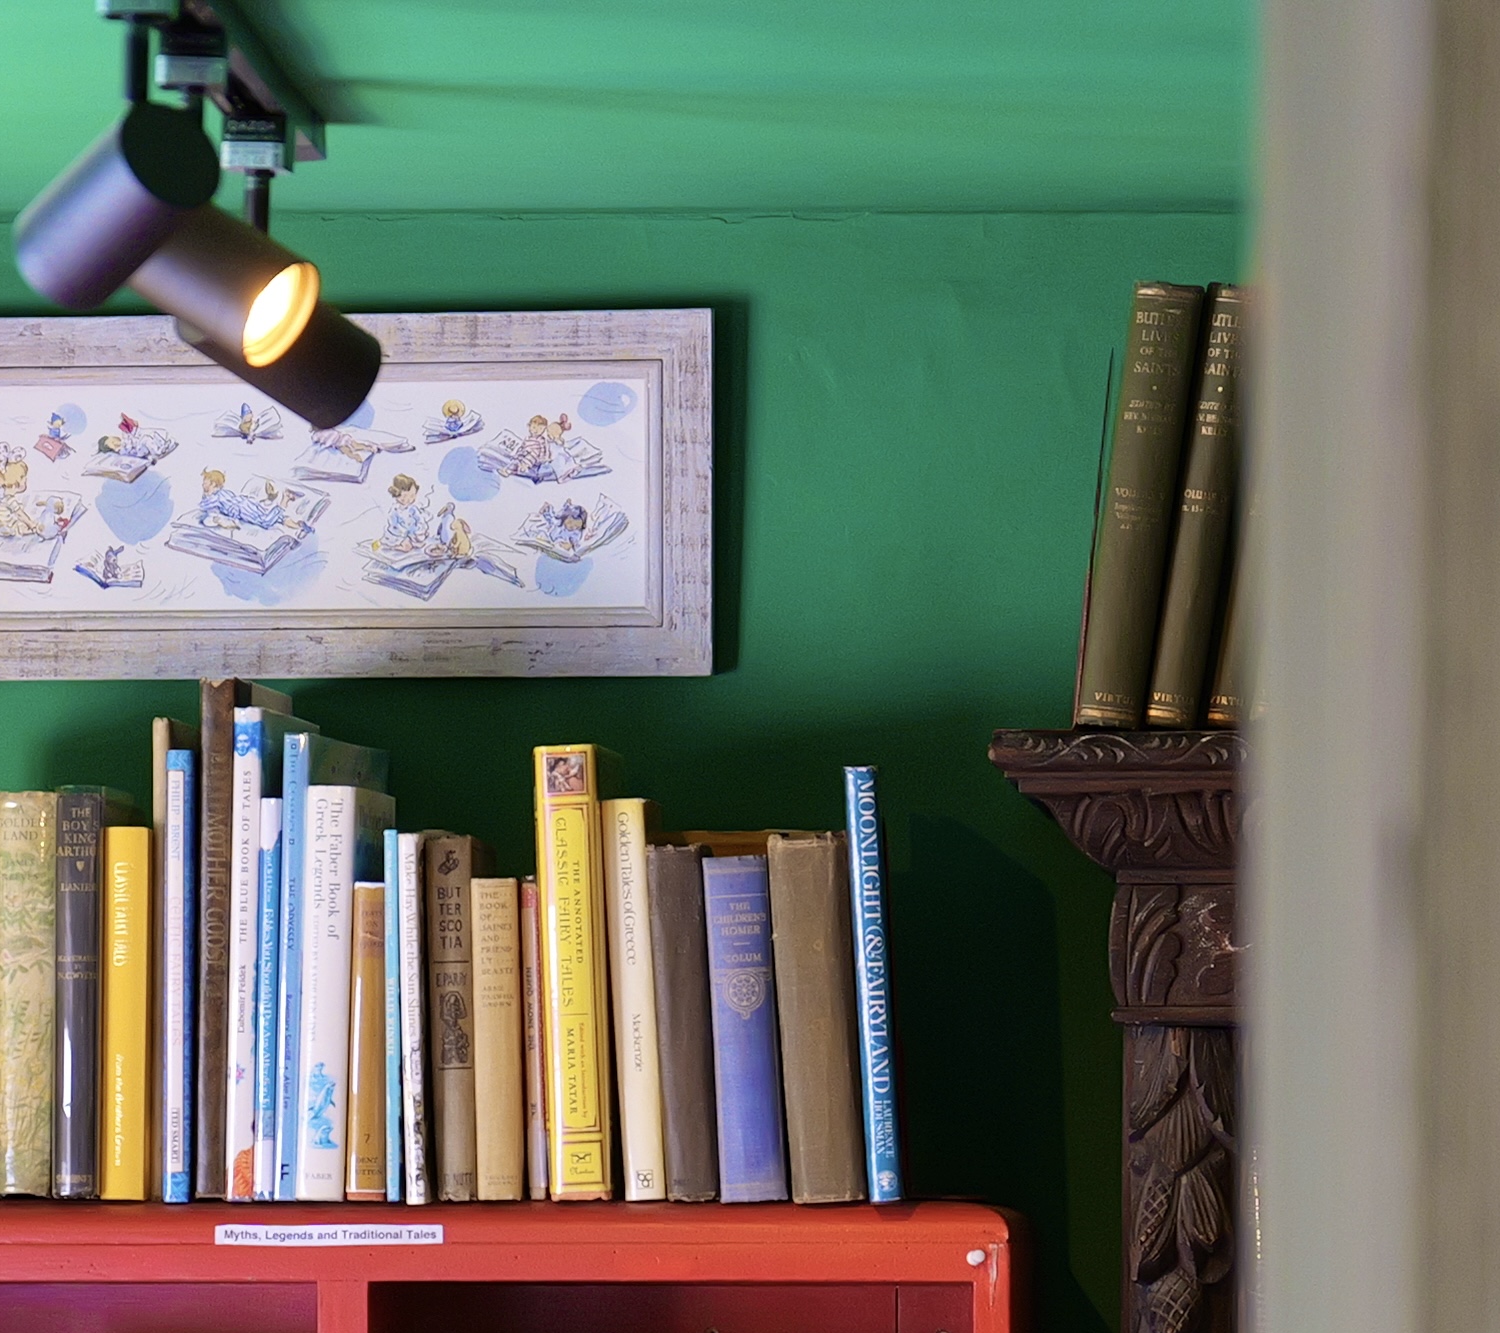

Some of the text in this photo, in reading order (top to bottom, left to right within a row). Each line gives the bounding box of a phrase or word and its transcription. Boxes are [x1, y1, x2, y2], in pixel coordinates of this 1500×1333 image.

[3, 830, 38, 841] LAND
[65, 833, 97, 845] KING
[71, 807, 91, 817] THE
[311, 797, 329, 910] Greek Legends
[327, 797, 345, 941] The Faber Book of
[857, 779, 885, 924] MOONLIGHT
[437, 886, 461, 901] BUT
[438, 903, 462, 916] TER
[554, 817, 575, 1008] CLASSIC FAIRY TALES
[571, 859, 584, 964] THE ANNOTATED
[439, 919, 463, 932] SCO
[440, 935, 463, 950] TIA
[616, 812, 645, 1072] Golden Tales of Greece Mackenzie
[721, 924, 761, 937] HOMER
[866, 959, 891, 1094] FAIRYLAND
[566, 1027, 578, 1116] MARIA TATAR
[873, 1098, 887, 1156] HOUSMAN
[882, 1098, 896, 1159] LAURENCE
[224, 1228, 437, 1242] Myths, Legends and Traditional Tales
